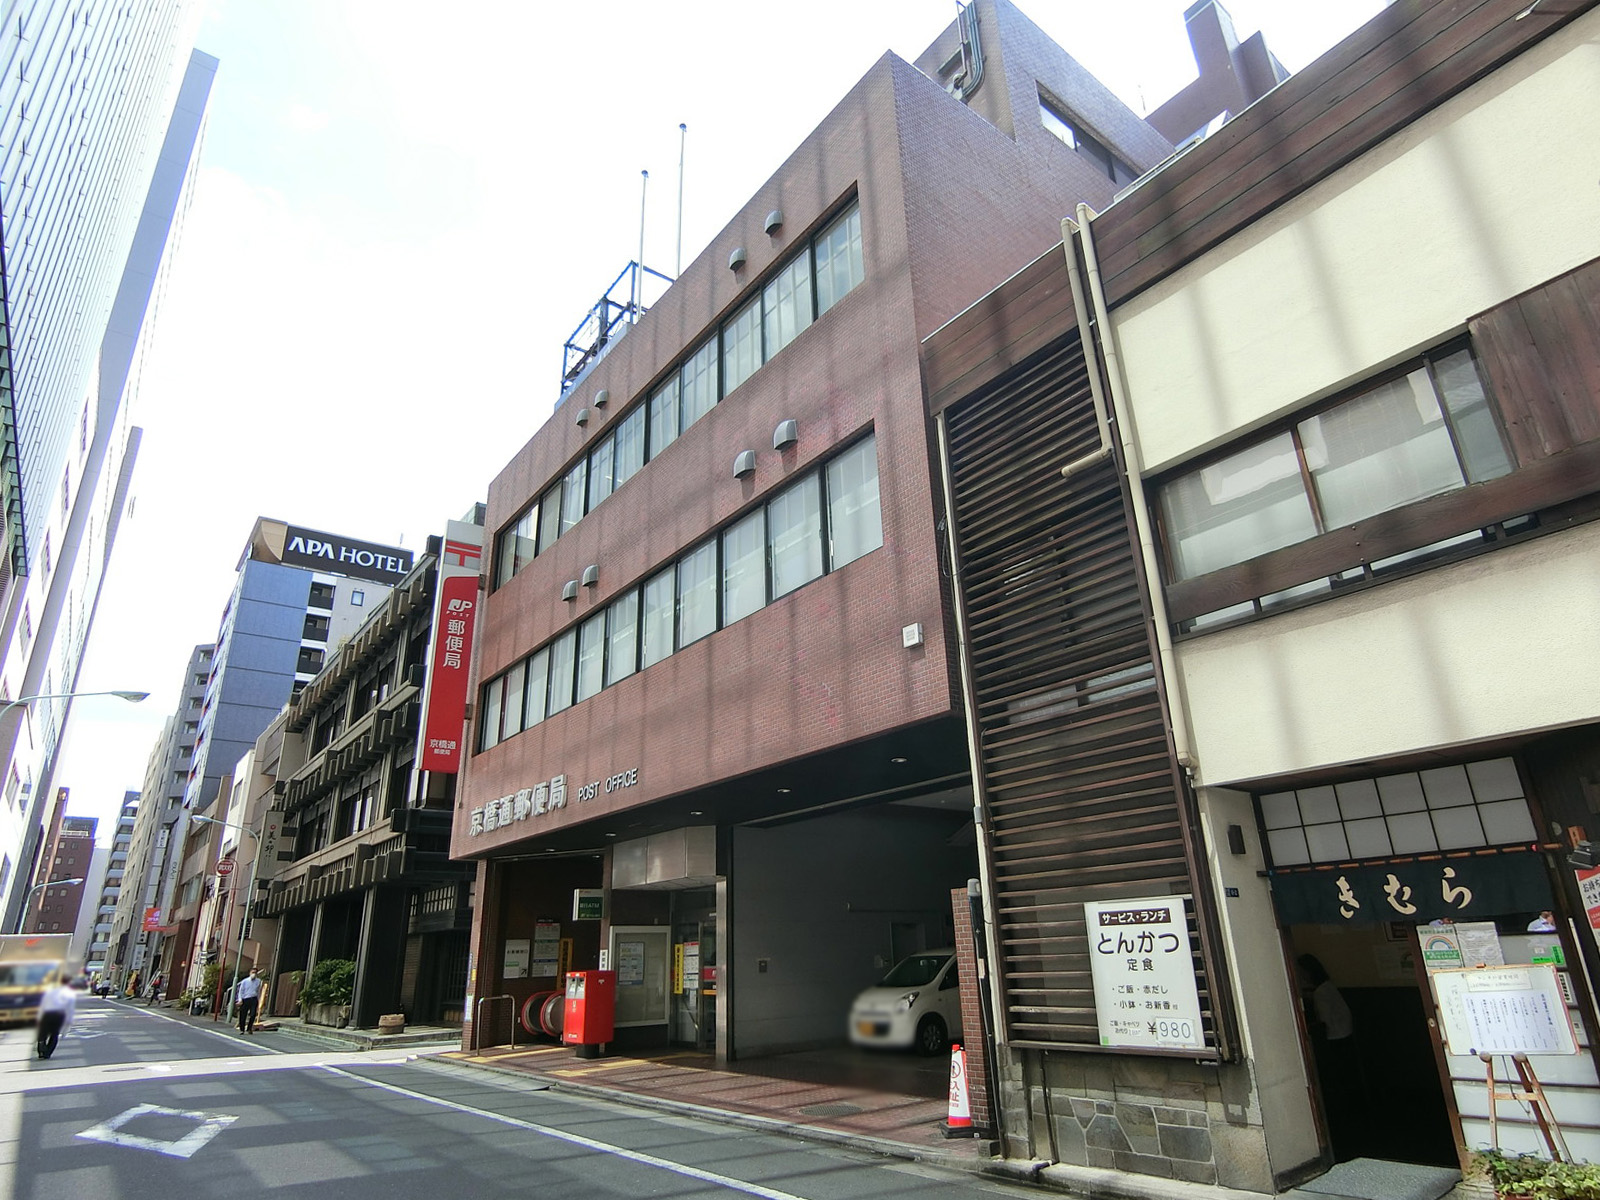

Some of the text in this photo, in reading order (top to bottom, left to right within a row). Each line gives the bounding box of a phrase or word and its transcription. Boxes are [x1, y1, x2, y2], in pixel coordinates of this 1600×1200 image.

[288, 536, 409, 575] APA HOTEL
[443, 619, 466, 670] 郵便局
[429, 738, 456, 750] 京橋通
[469, 767, 639, 836] 京橋通郵便局 POST OFFICE
[1335, 866, 1473, 919] きむら
[1102, 910, 1167, 924] サービス・ランチ
[1097, 930, 1180, 954] とんかつ
[1127, 958, 1155, 972] 定食
[1147, 1021, 1192, 1039] ¥980
